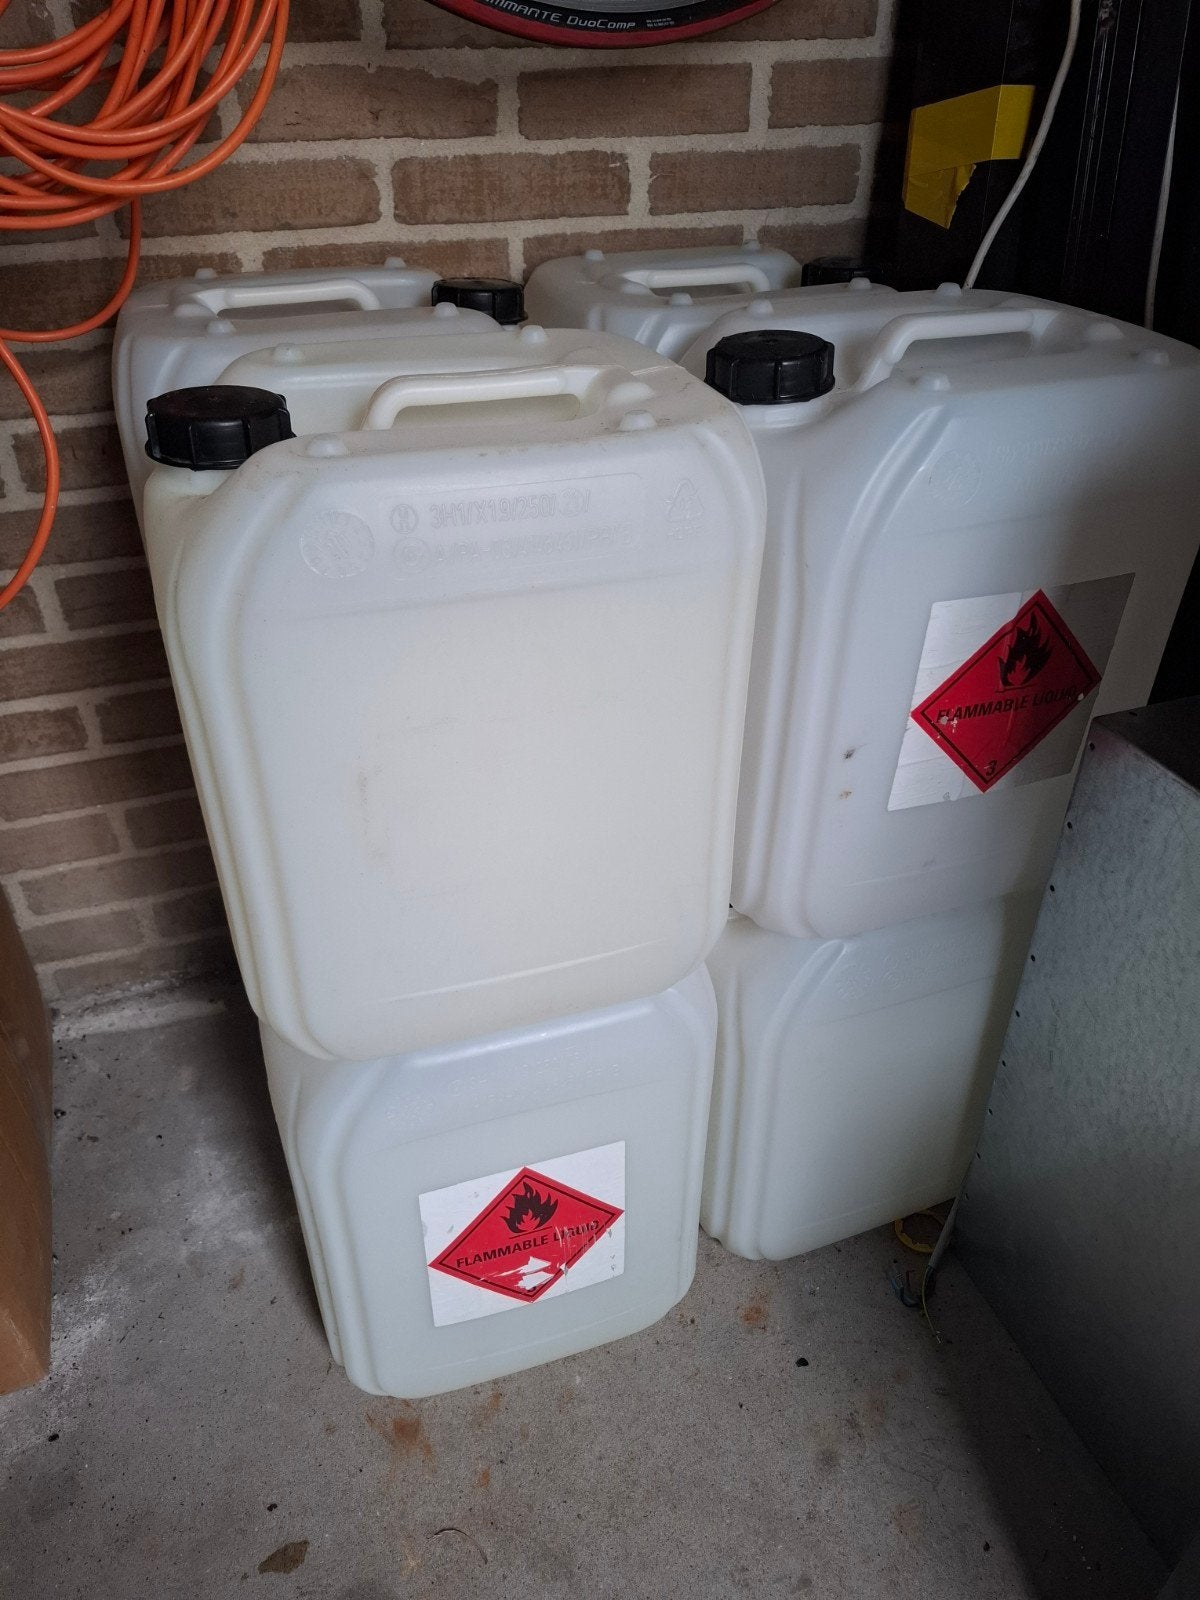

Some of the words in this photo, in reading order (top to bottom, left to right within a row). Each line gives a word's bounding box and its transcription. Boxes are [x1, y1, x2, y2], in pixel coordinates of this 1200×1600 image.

[936, 695, 1029, 724] FLAMMABLE
[985, 759, 998, 776] 3
[456, 1235, 549, 1268] FLAMMABLE
